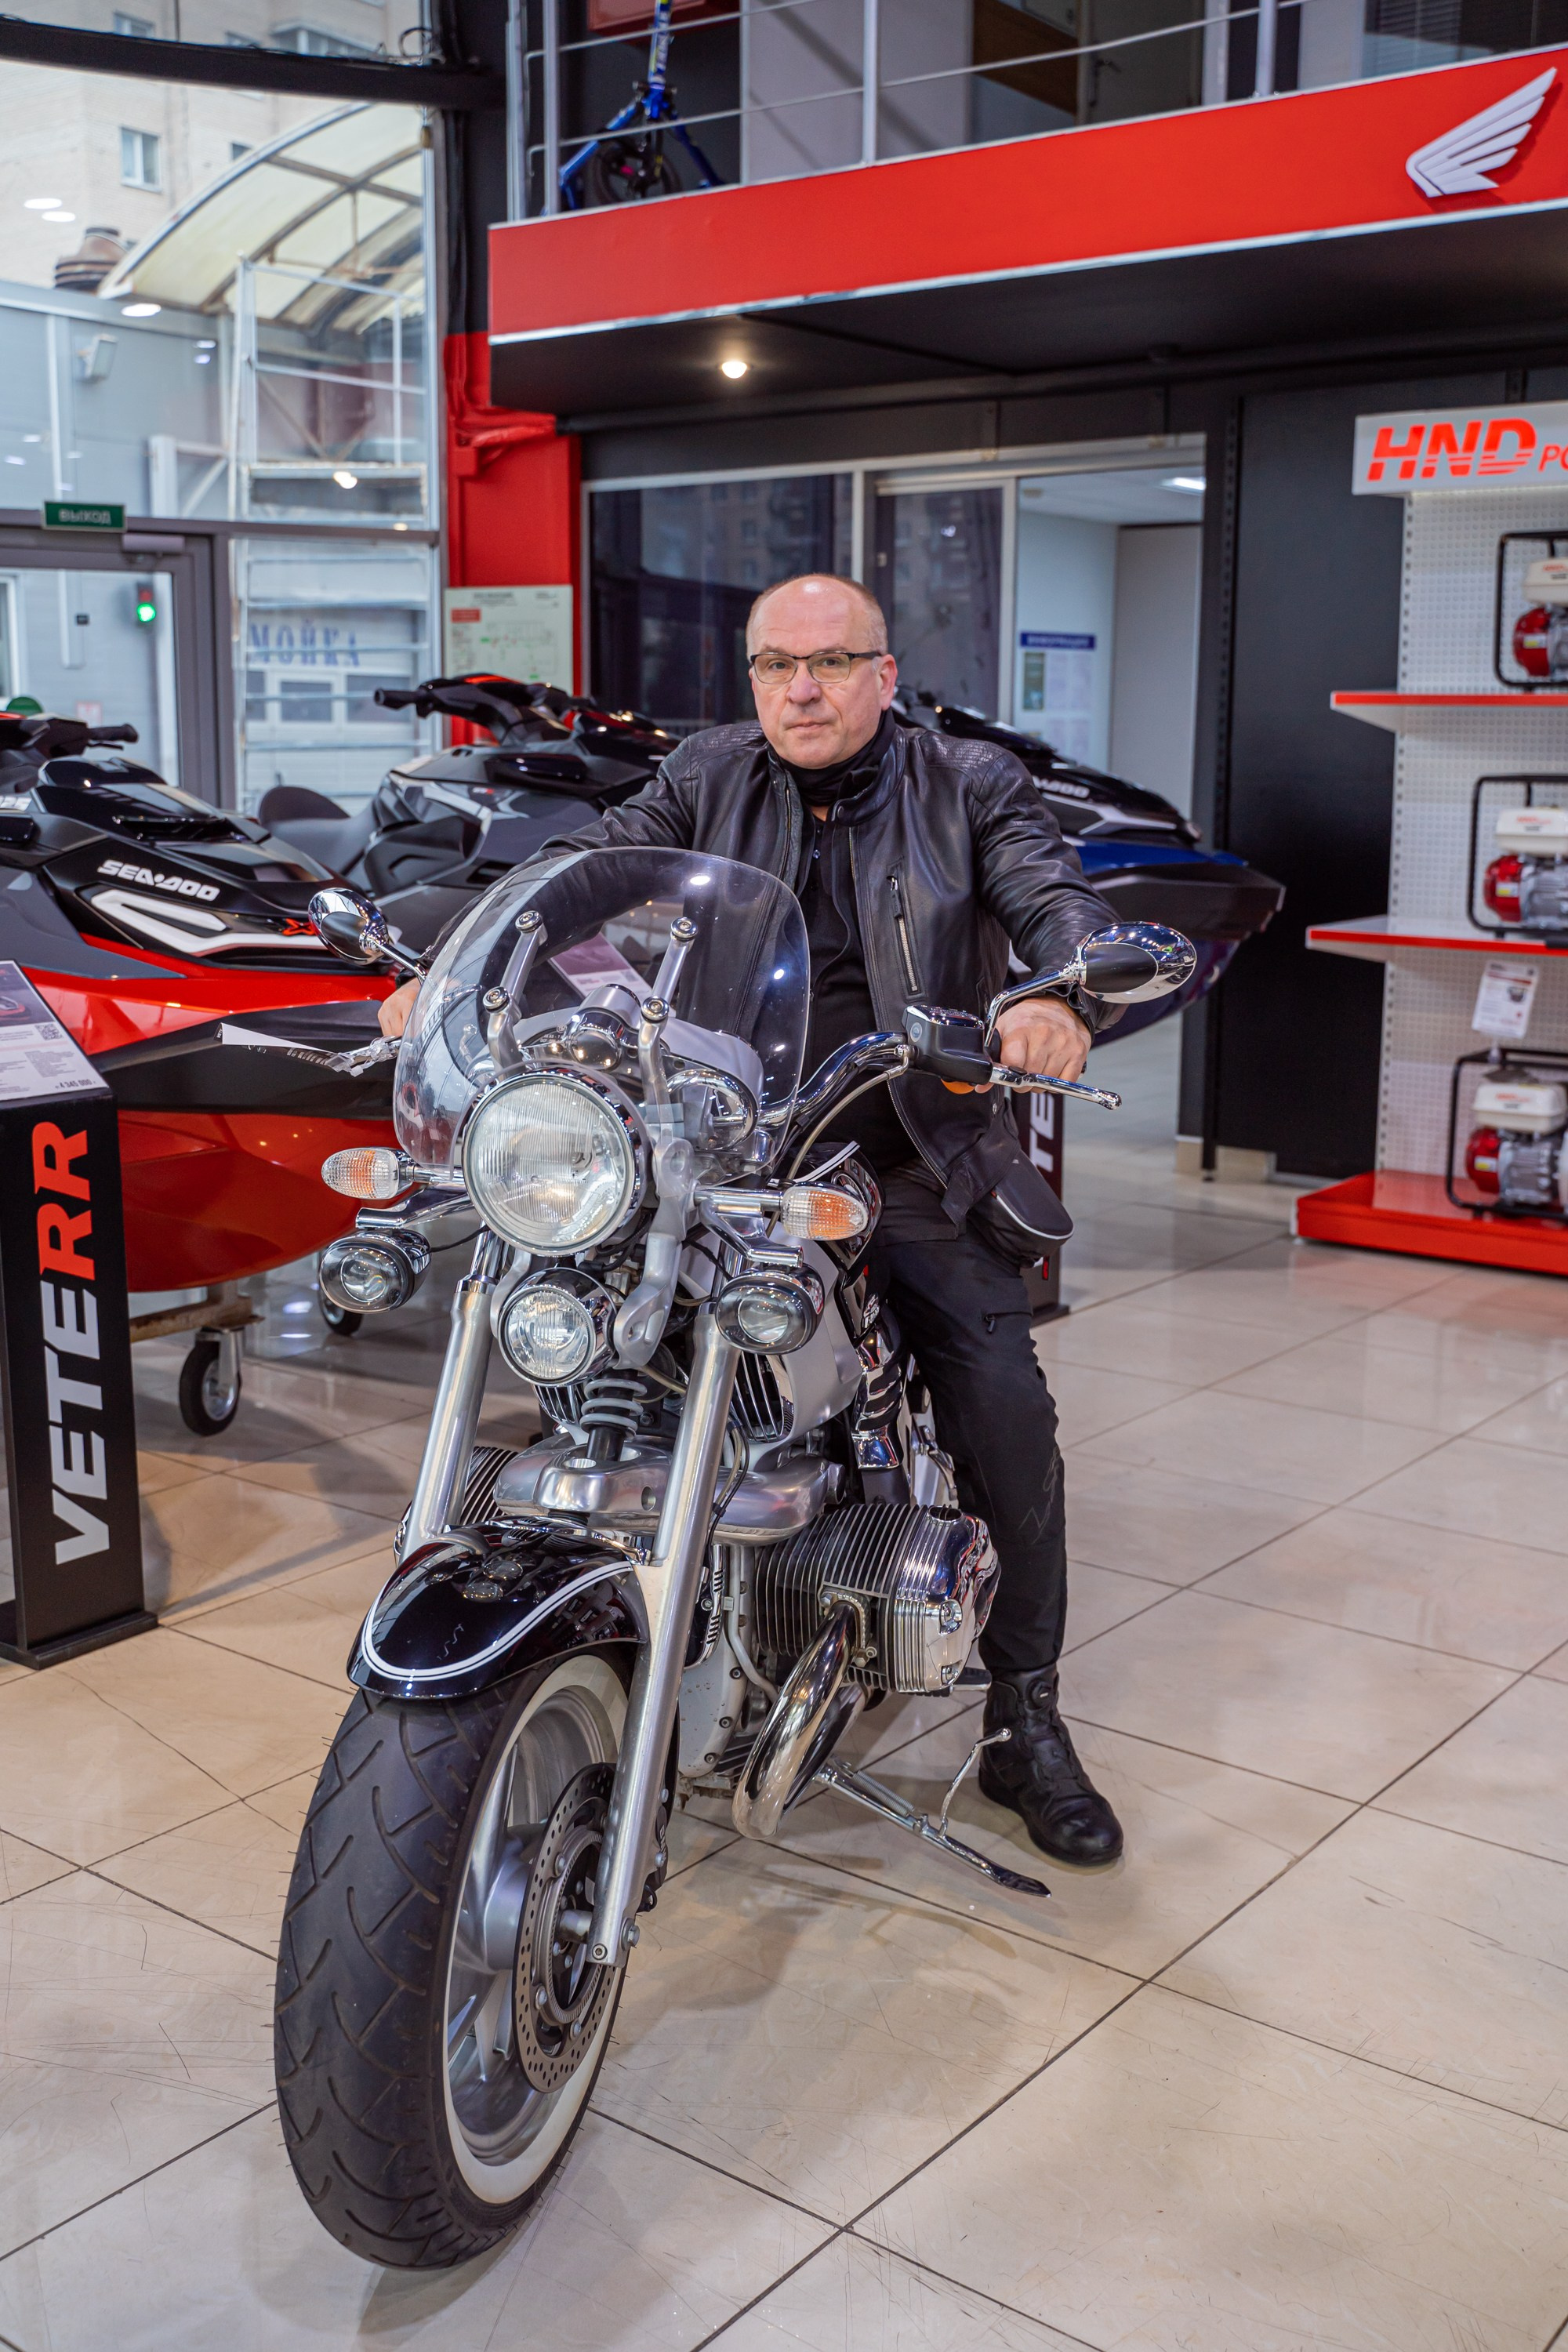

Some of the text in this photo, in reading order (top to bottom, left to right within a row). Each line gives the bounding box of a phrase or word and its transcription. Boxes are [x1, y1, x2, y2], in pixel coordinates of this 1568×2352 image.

[1367, 417, 1537, 481] HND
[58, 508, 112, 526] ВЫХОД
[31, 1120, 110, 1566] VETERR
